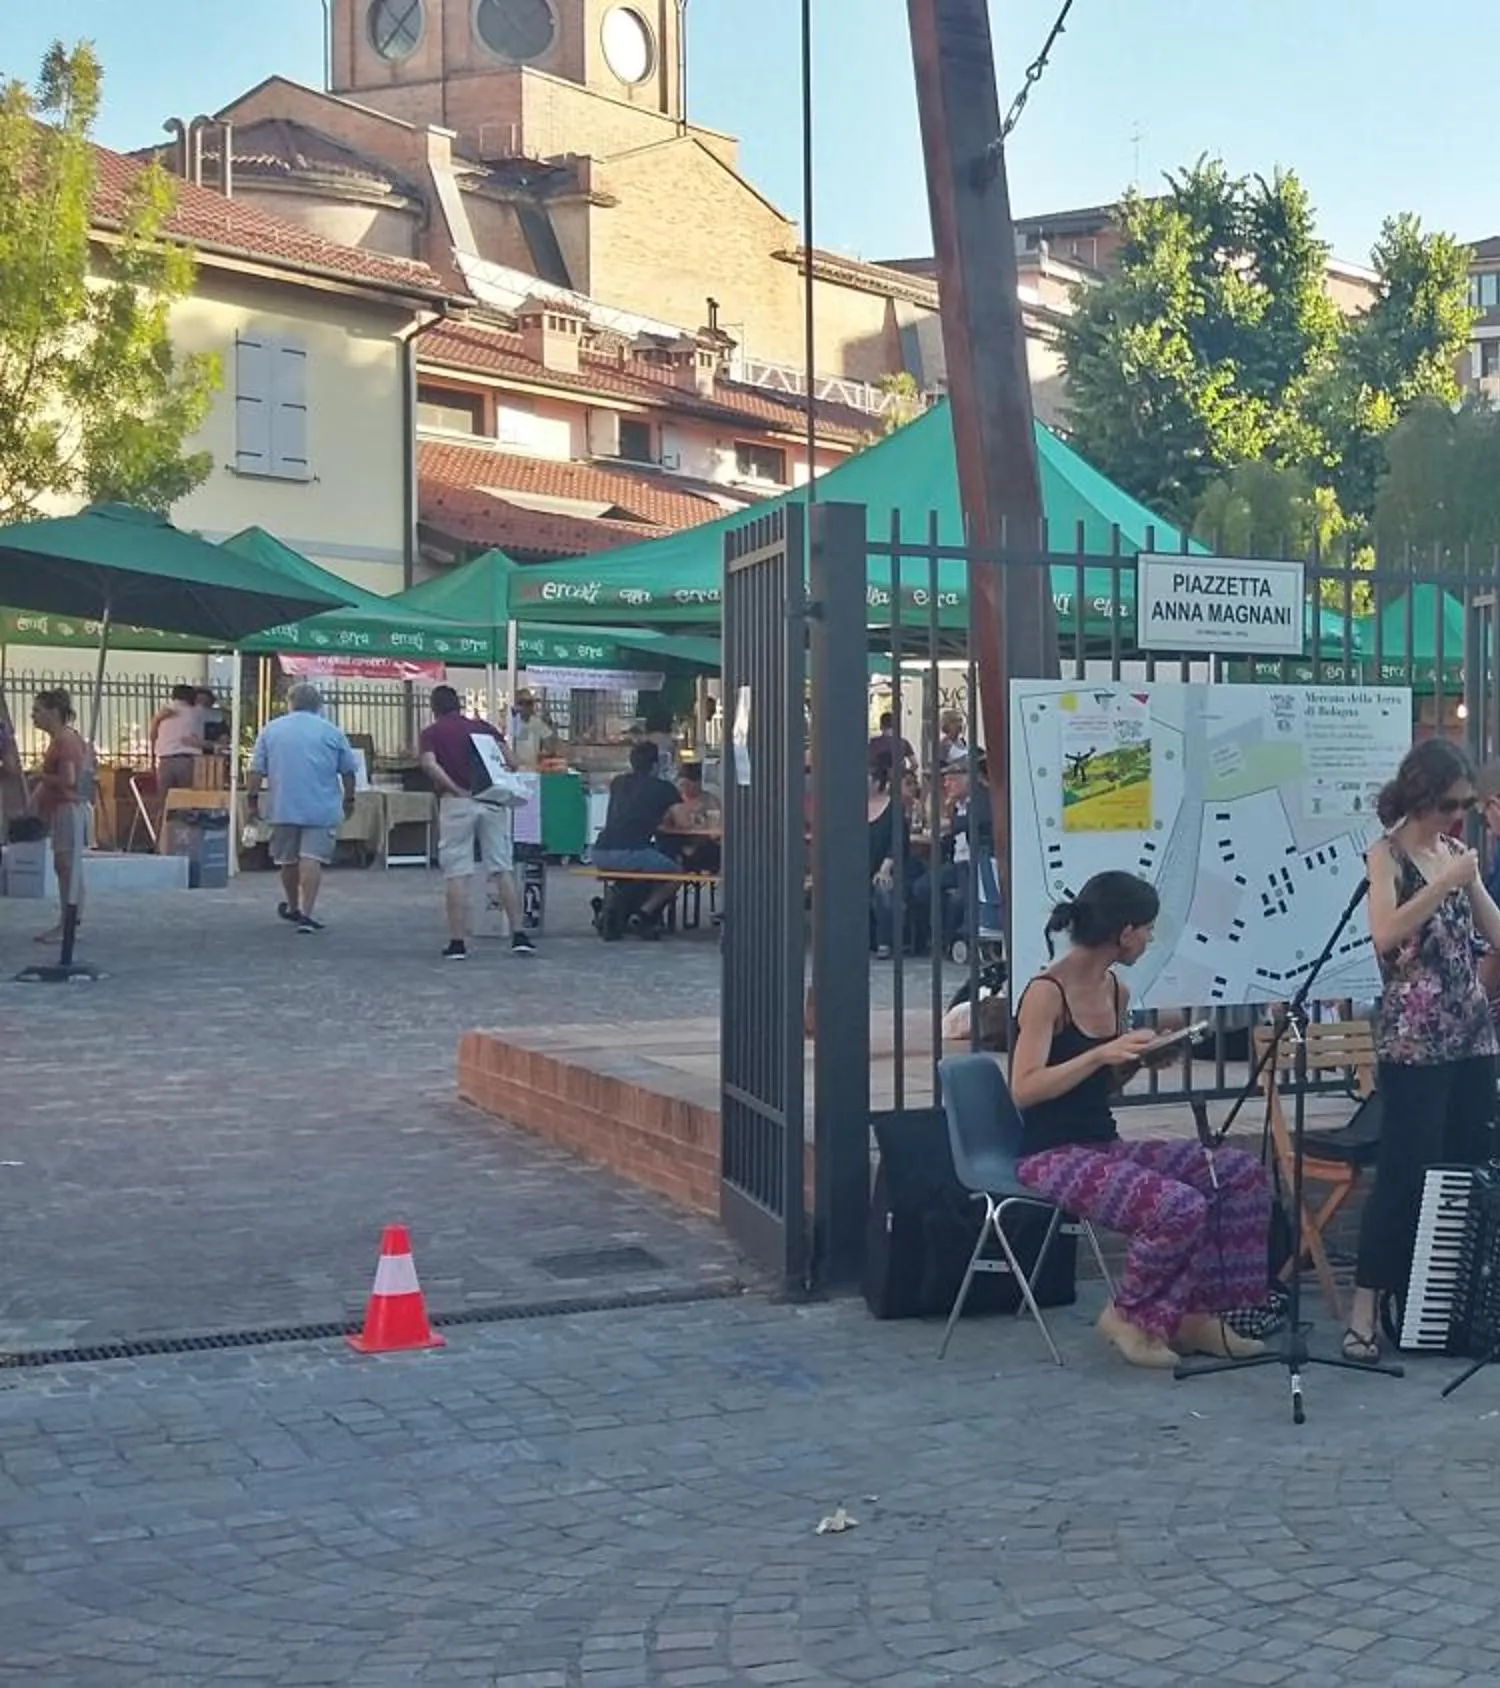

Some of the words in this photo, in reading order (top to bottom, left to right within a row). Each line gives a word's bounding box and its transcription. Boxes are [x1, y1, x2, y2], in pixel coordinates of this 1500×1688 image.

[1172, 573, 1272, 598] PIAZZETTA
[1151, 600, 1204, 622] ANNA
[1208, 602, 1292, 625] MAGNANI
